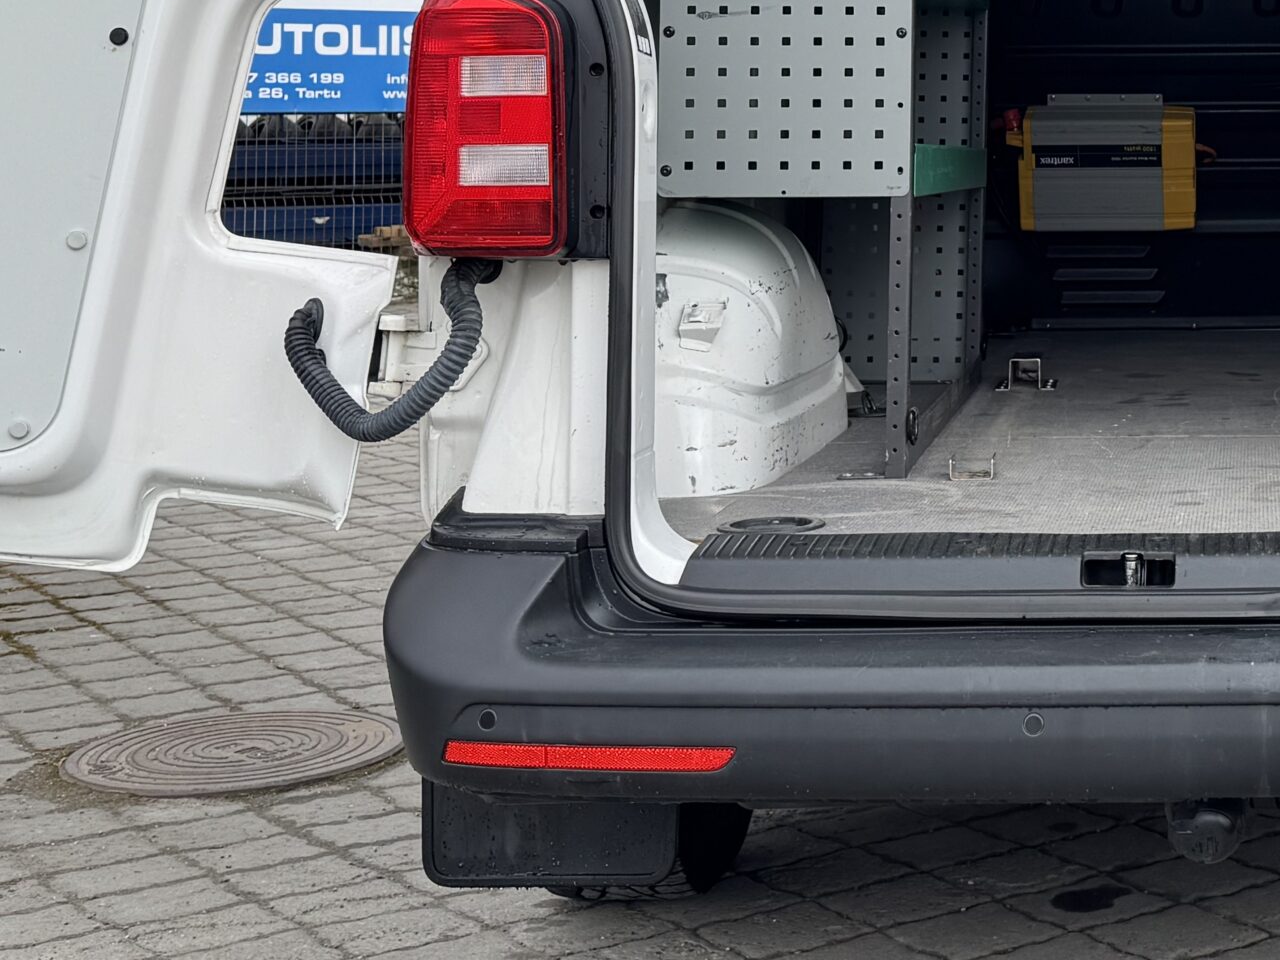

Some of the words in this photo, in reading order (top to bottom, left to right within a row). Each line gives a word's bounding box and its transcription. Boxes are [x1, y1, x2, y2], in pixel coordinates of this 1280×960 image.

[254, 23, 411, 56] UTOLII
[264, 72, 301, 84] 366
[309, 72, 344, 84] 199
[258, 87, 288, 100] 26,
[295, 87, 341, 99] Tartu
[1040, 156, 1074, 165] xantrex
